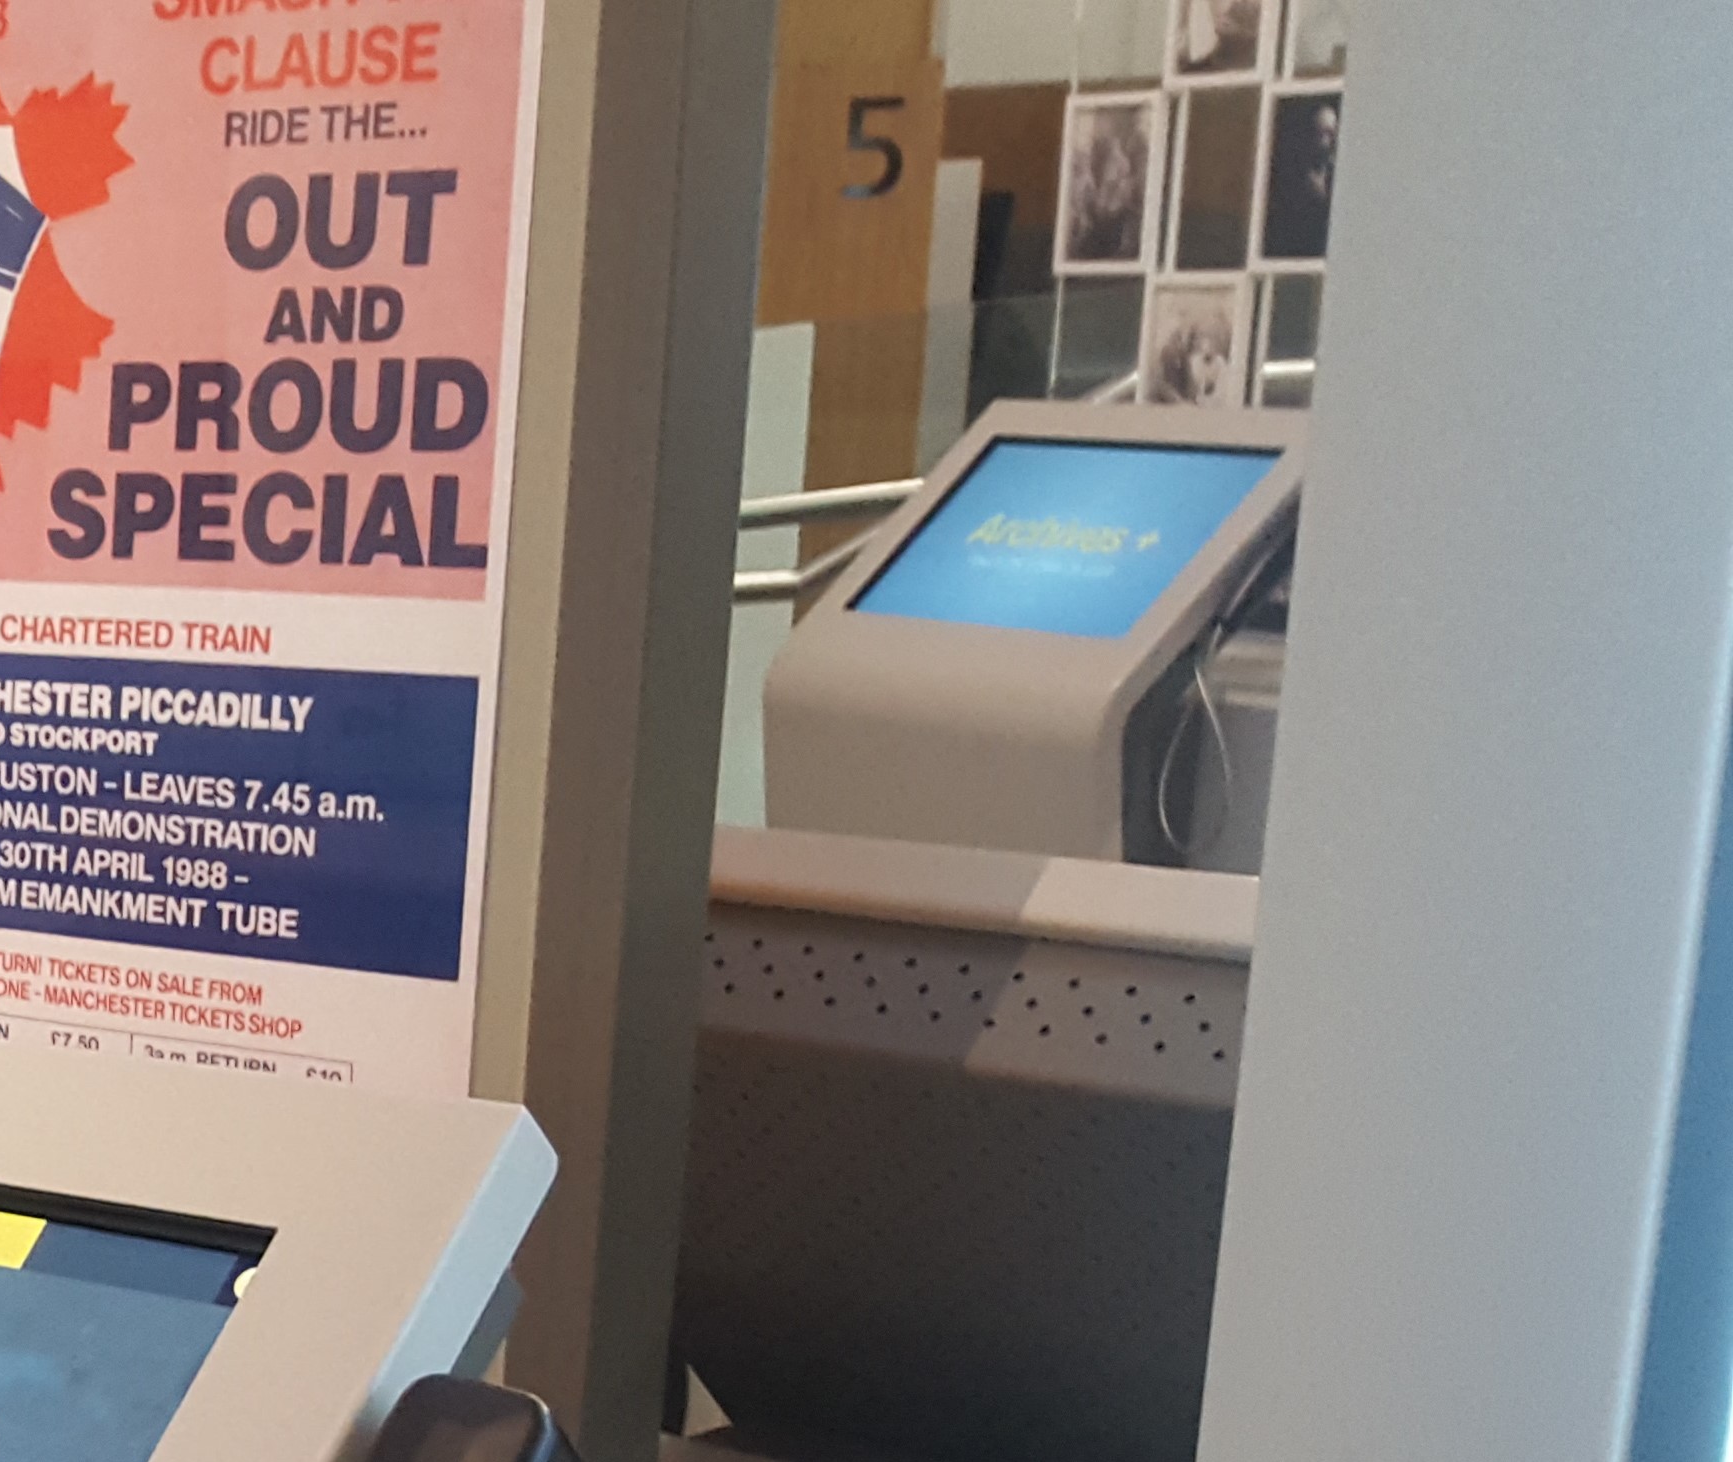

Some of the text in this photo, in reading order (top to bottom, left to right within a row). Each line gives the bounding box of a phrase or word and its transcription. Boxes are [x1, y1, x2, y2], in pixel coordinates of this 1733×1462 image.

[200, 22, 441, 96] CLAUSE
[224, 101, 427, 147] RIDE THE...
[838, 95, 905, 197] 5
[225, 169, 457, 272] OUT
[264, 285, 403, 344] AND
[107, 356, 489, 454] PROUD
[46, 469, 487, 569] SPECIAL
[966, 512, 1131, 555] Archives
[0, 613, 174, 650] CHARTERED
[180, 621, 271, 655] TRAIN
[119, 686, 314, 733] PICCADILLY
[9, 721, 159, 757] STOCKPORT
[124, 770, 236, 809] LEAVES
[243, 779, 311, 816] 7.45
[317, 791, 384, 822] a.m.
[59, 804, 317, 858] DEMONSTRATION
[72, 846, 155, 883] APRIL
[162, 855, 228, 891] 1988
[20, 879, 208, 929] EMANKMENT
[216, 901, 299, 939] TUBE
[47, 957, 121, 988] TICKETS
[125, 967, 153, 991] ON
[156, 971, 204, 999] SALE
[207, 978, 264, 1007] FROM
[43, 983, 166, 1020] MANCHESTER
[168, 1001, 246, 1033] TICKETS
[247, 1012, 303, 1040] SHOP
